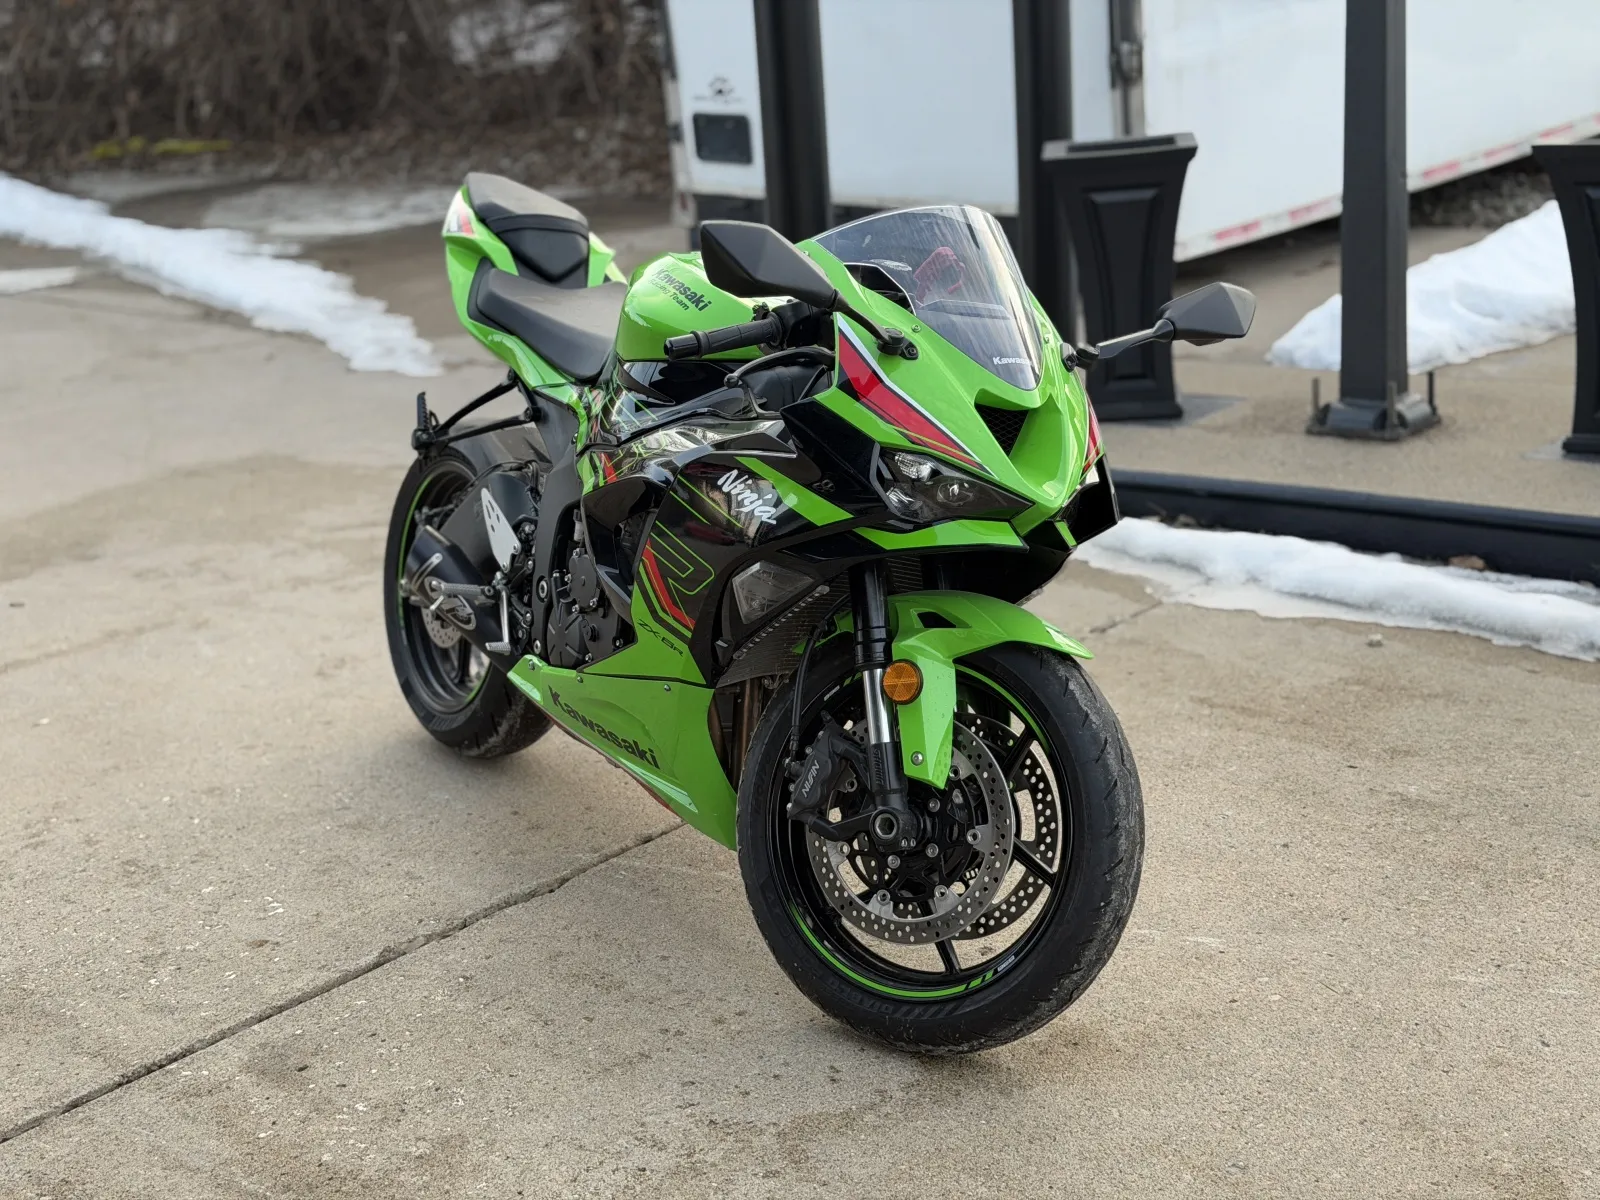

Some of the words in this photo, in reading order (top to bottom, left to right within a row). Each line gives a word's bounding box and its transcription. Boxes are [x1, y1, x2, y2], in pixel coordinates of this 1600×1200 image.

[652, 268, 712, 311] Kawasaki
[670, 291, 689, 311] Team
[717, 469, 777, 525] Ninja
[637, 618, 684, 657] ZX-6R
[548, 685, 660, 769] Kawasaki
